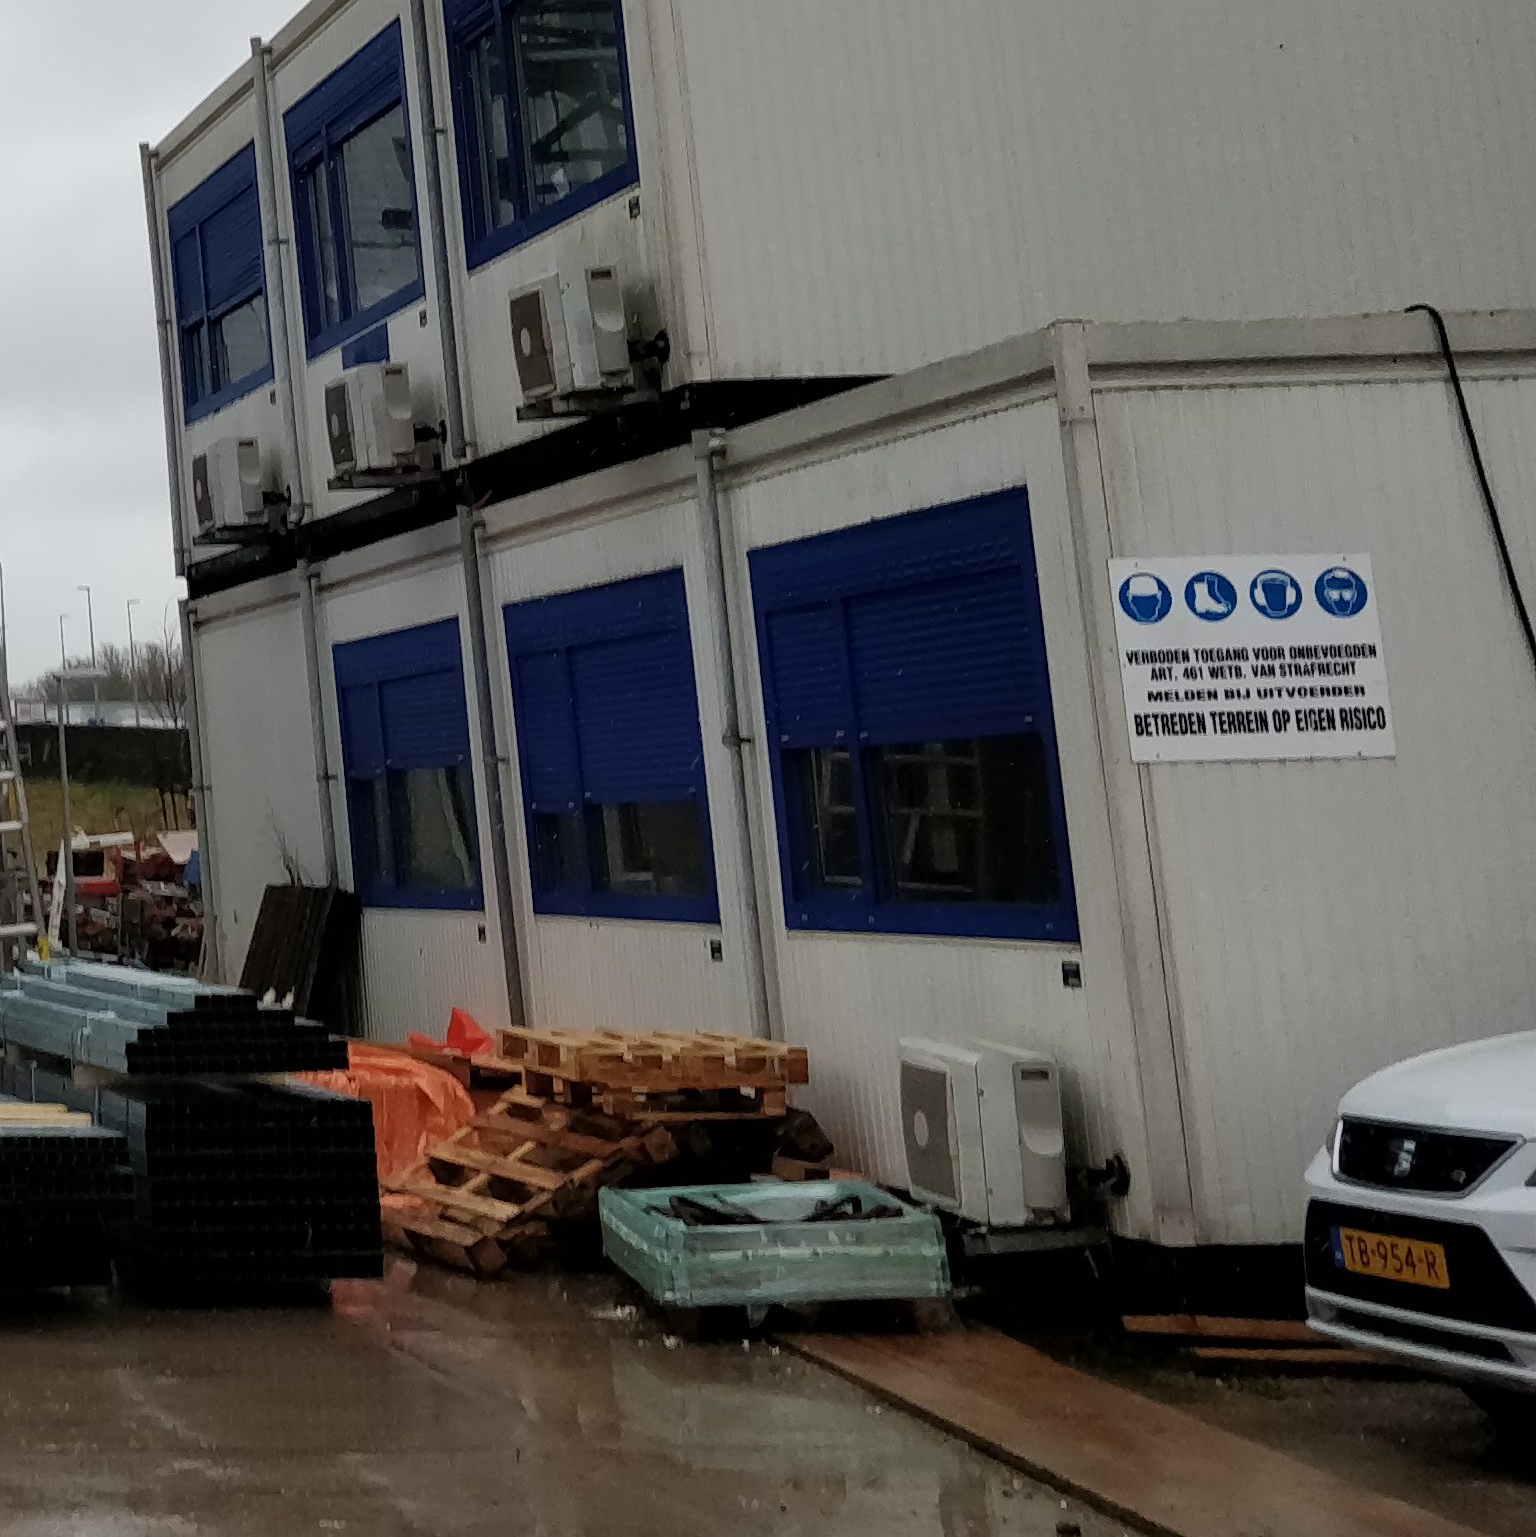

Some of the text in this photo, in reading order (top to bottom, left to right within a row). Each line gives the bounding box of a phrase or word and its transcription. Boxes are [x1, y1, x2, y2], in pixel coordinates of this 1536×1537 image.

[1125, 642, 1377, 665] VERBODEN TOEGANG VOOR ONBEVOEGDEN
[1150, 666, 1178, 681] ART.
[1251, 663, 1276, 678] VAN
[1279, 661, 1357, 678] STRAFRECHT
[1146, 688, 1218, 702] MELDEN
[1224, 687, 1251, 701] BIJ
[1133, 704, 1387, 737] BETREDEN TERREIN OP EIGEN RISICO
[1343, 1233, 1441, 1280] TB-954-R
